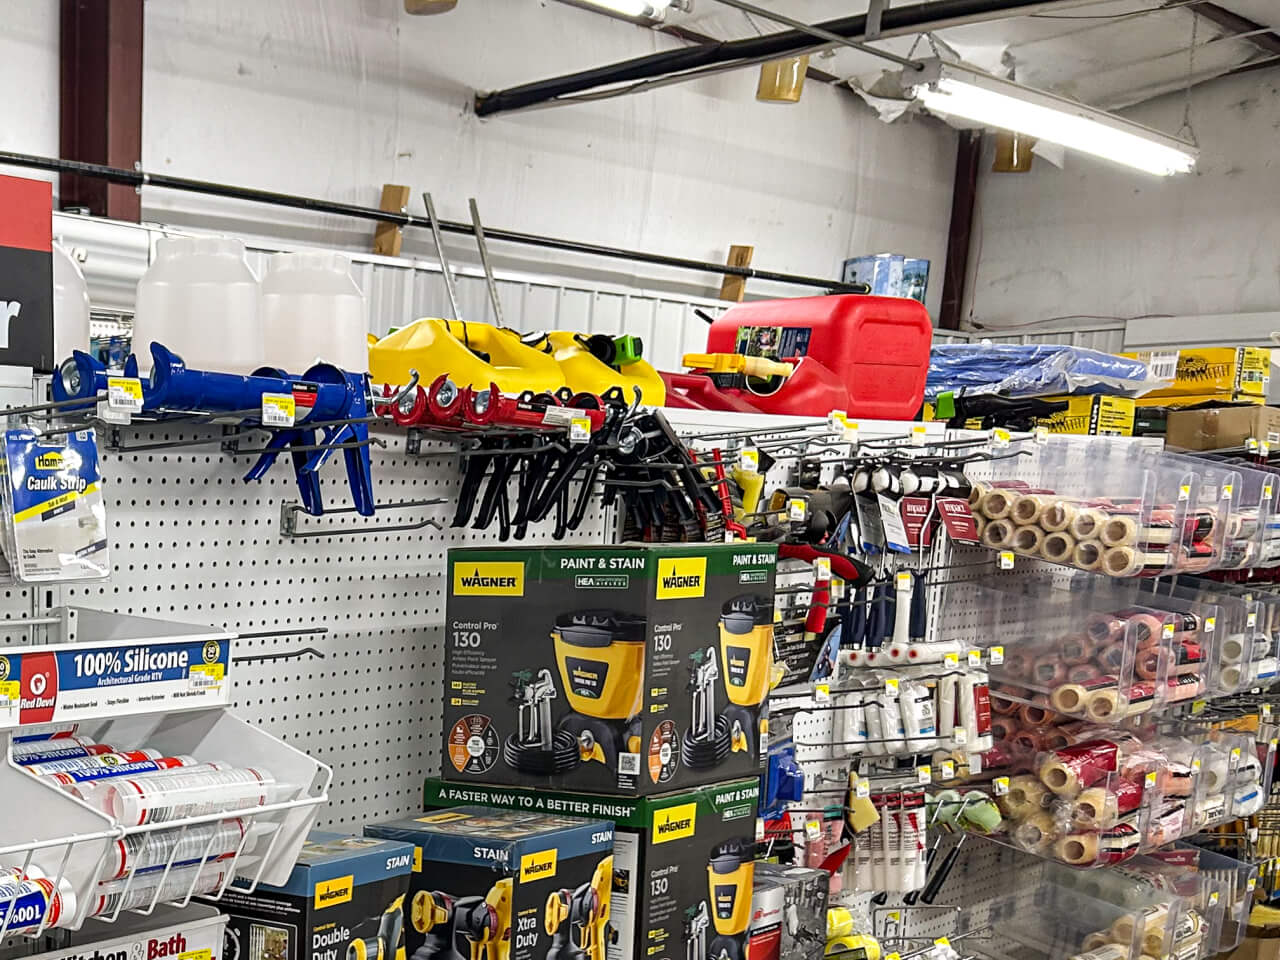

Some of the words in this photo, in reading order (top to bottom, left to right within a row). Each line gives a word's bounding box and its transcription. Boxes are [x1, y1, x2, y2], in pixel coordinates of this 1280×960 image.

[561, 558, 595, 569] PAINT
[599, 558, 607, 569] &
[609, 558, 645, 569] STAIN
[461, 568, 517, 588] WAGNER
[663, 565, 701, 588] WAGNER
[453, 621, 481, 631] Control
[483, 621, 497, 631] Pro
[453, 633, 480, 648] 130
[74, 651, 121, 676] 100%
[124, 650, 188, 673] Silicone
[439, 789, 446, 799] A
[449, 790, 488, 803] FASTER
[490, 793, 515, 805] WAY
[519, 796, 533, 806] TO
[535, 798, 545, 808] A
[547, 799, 590, 813] BETTER
[592, 804, 631, 817] FINISH
[657, 817, 691, 834] WAGNER
[591, 831, 612, 844] STAIN
[473, 847, 509, 861] STAIN
[385, 855, 410, 871] STAIN
[524, 860, 553, 876] WAGNER
[319, 886, 350, 903] WAGNER
[650, 878, 668, 896] 130
[517, 916, 536, 933] Xtra
[129, 940, 145, 960] &
[147, 933, 186, 960] Bath
[312, 927, 350, 949] Double
[516, 931, 538, 949] Duty
